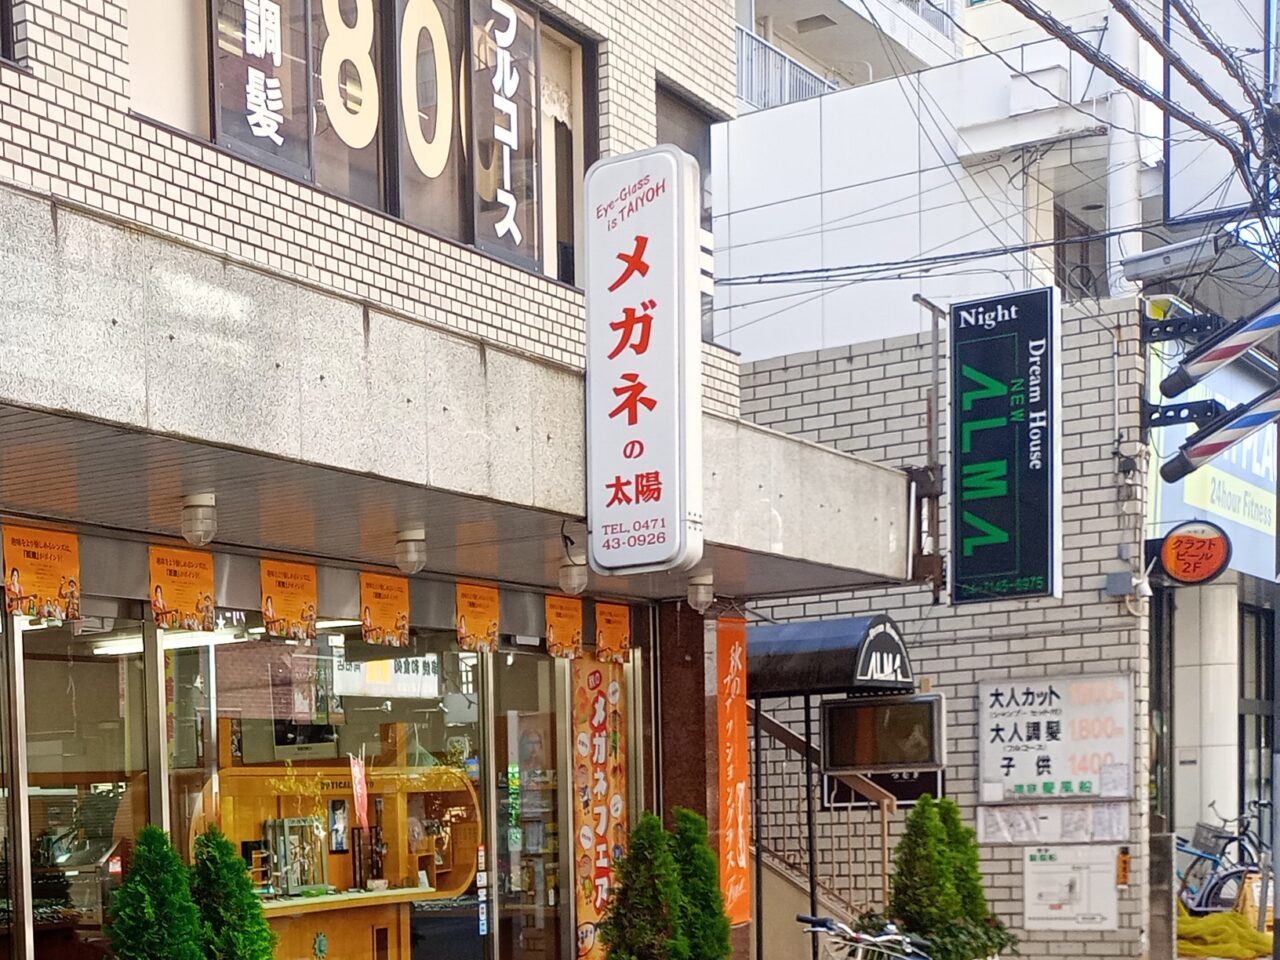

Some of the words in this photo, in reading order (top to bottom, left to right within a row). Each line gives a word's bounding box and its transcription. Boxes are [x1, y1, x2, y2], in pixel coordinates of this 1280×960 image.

[595, 174, 651, 221] Eye-Glass
[607, 218, 618, 231] is
[618, 178, 667, 223] TAIYOH
[958, 303, 1019, 329] Night
[1028, 337, 1047, 404] Dream
[1010, 378, 1025, 423] NEW
[1028, 409, 1048, 471] House
[1210, 476, 1242, 513] 24hour
[1243, 489, 1272, 527] Fitness
[632, 518, 666, 534] 0471
[602, 532, 666, 551] 43-0926
[1171, 538, 1216, 551] クラフト
[1176, 550, 1214, 562] ビール
[1182, 561, 1202, 573] 2F
[989, 685, 1061, 708] 大人カット
[990, 720, 1062, 744] 大人調髪
